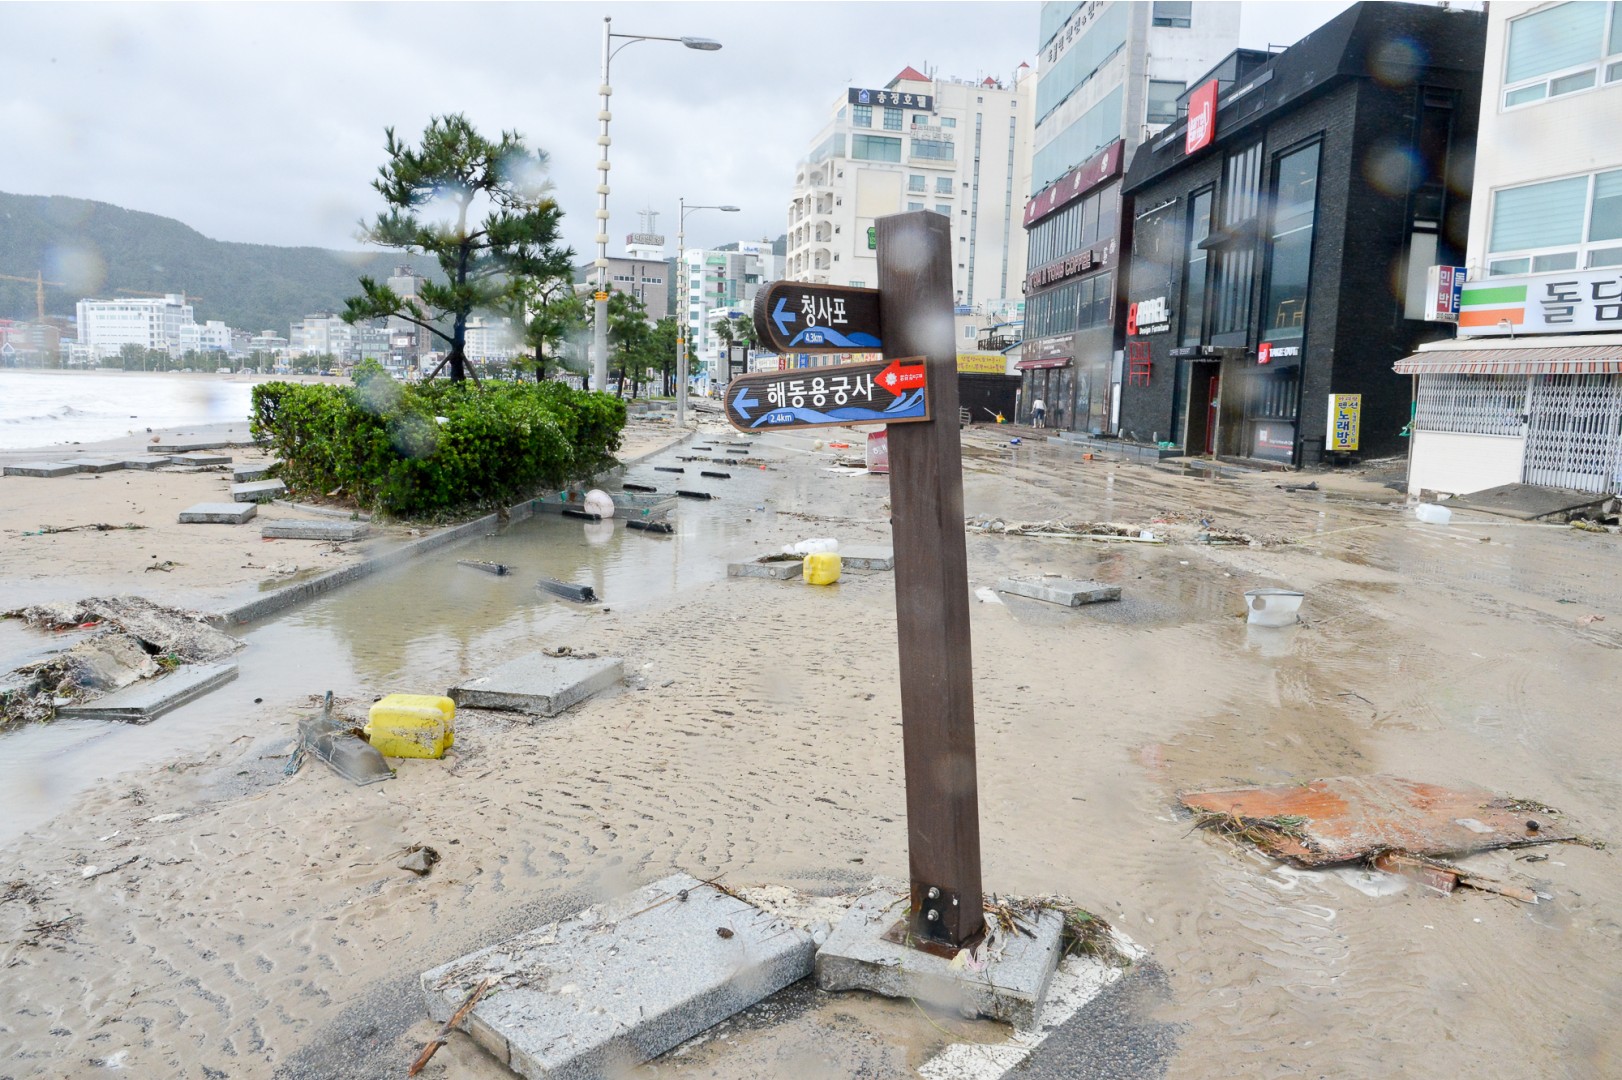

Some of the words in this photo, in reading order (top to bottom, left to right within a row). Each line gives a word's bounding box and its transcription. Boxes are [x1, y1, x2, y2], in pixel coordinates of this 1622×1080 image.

[877, 91, 926, 108] 송정호텔
[1065, 250, 1091, 276] COFFEE
[1439, 270, 1450, 308] 민박
[801, 295, 848, 327] 청사포
[805, 332, 823, 343] 4.3km
[767, 374, 874, 408] 해동용궁사
[770, 413, 792, 424] 2.4km
[1338, 401, 1358, 411] 펜션
[1336, 411, 1350, 445] 노래방
